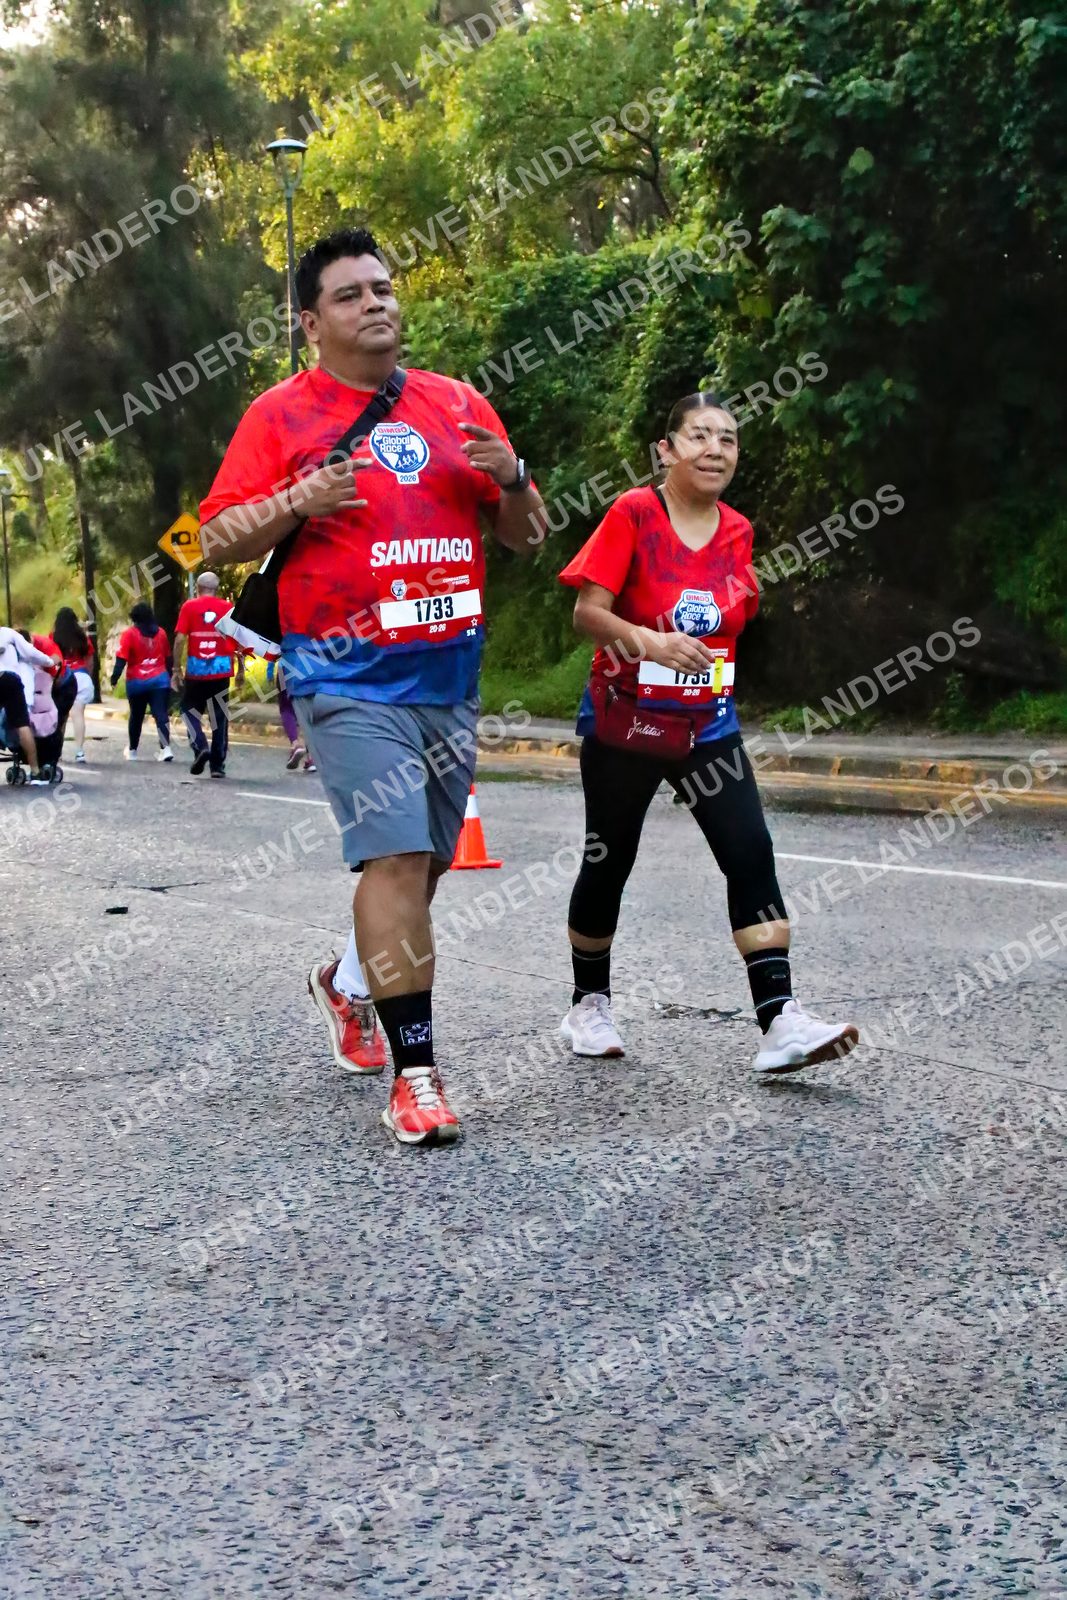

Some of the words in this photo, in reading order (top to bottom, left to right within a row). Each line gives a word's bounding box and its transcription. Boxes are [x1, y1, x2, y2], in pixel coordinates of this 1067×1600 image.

[382, 435, 411, 445] Global
[380, 443, 403, 452] Race
[400, 474, 417, 482] 2026
[370, 537, 473, 568] SANTIAGO
[414, 596, 454, 623] 1733
[686, 603, 710, 614] Global
[680, 610, 702, 621] Race
